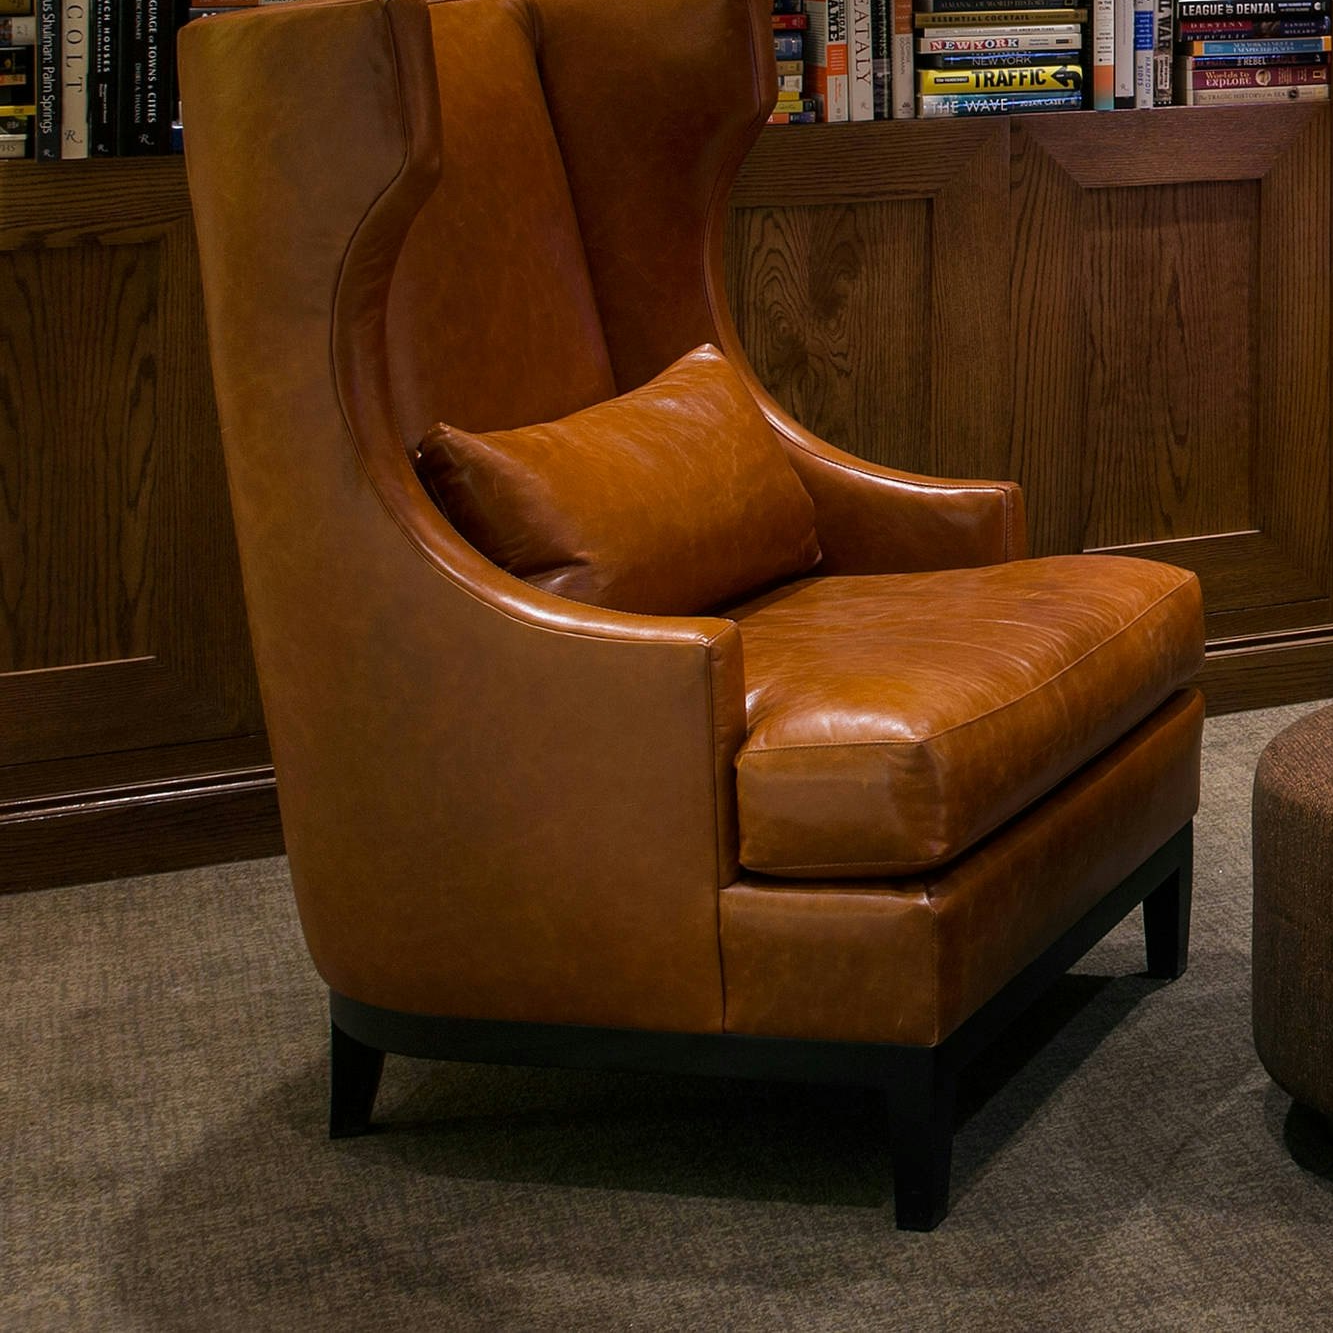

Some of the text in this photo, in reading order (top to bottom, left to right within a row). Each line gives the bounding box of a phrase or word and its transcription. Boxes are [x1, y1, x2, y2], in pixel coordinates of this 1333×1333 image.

[1183, 4, 1223, 15] LEAGUE
[1236, 2, 1275, 13] DENIAL
[40, 13, 56, 64] Shulman:
[930, 38, 1019, 50] NEW YORK
[1159, 15, 1171, 49] WAR
[65, 5, 82, 92] COLT
[103, 27, 111, 72] HOUSES
[972, 57, 1031, 66] NEW YORK
[40, 66, 56, 92] Palm
[971, 69, 1045, 88] TRAFFIC
[39, 94, 56, 133] Springs
[931, 98, 1007, 114] THE WAVE
